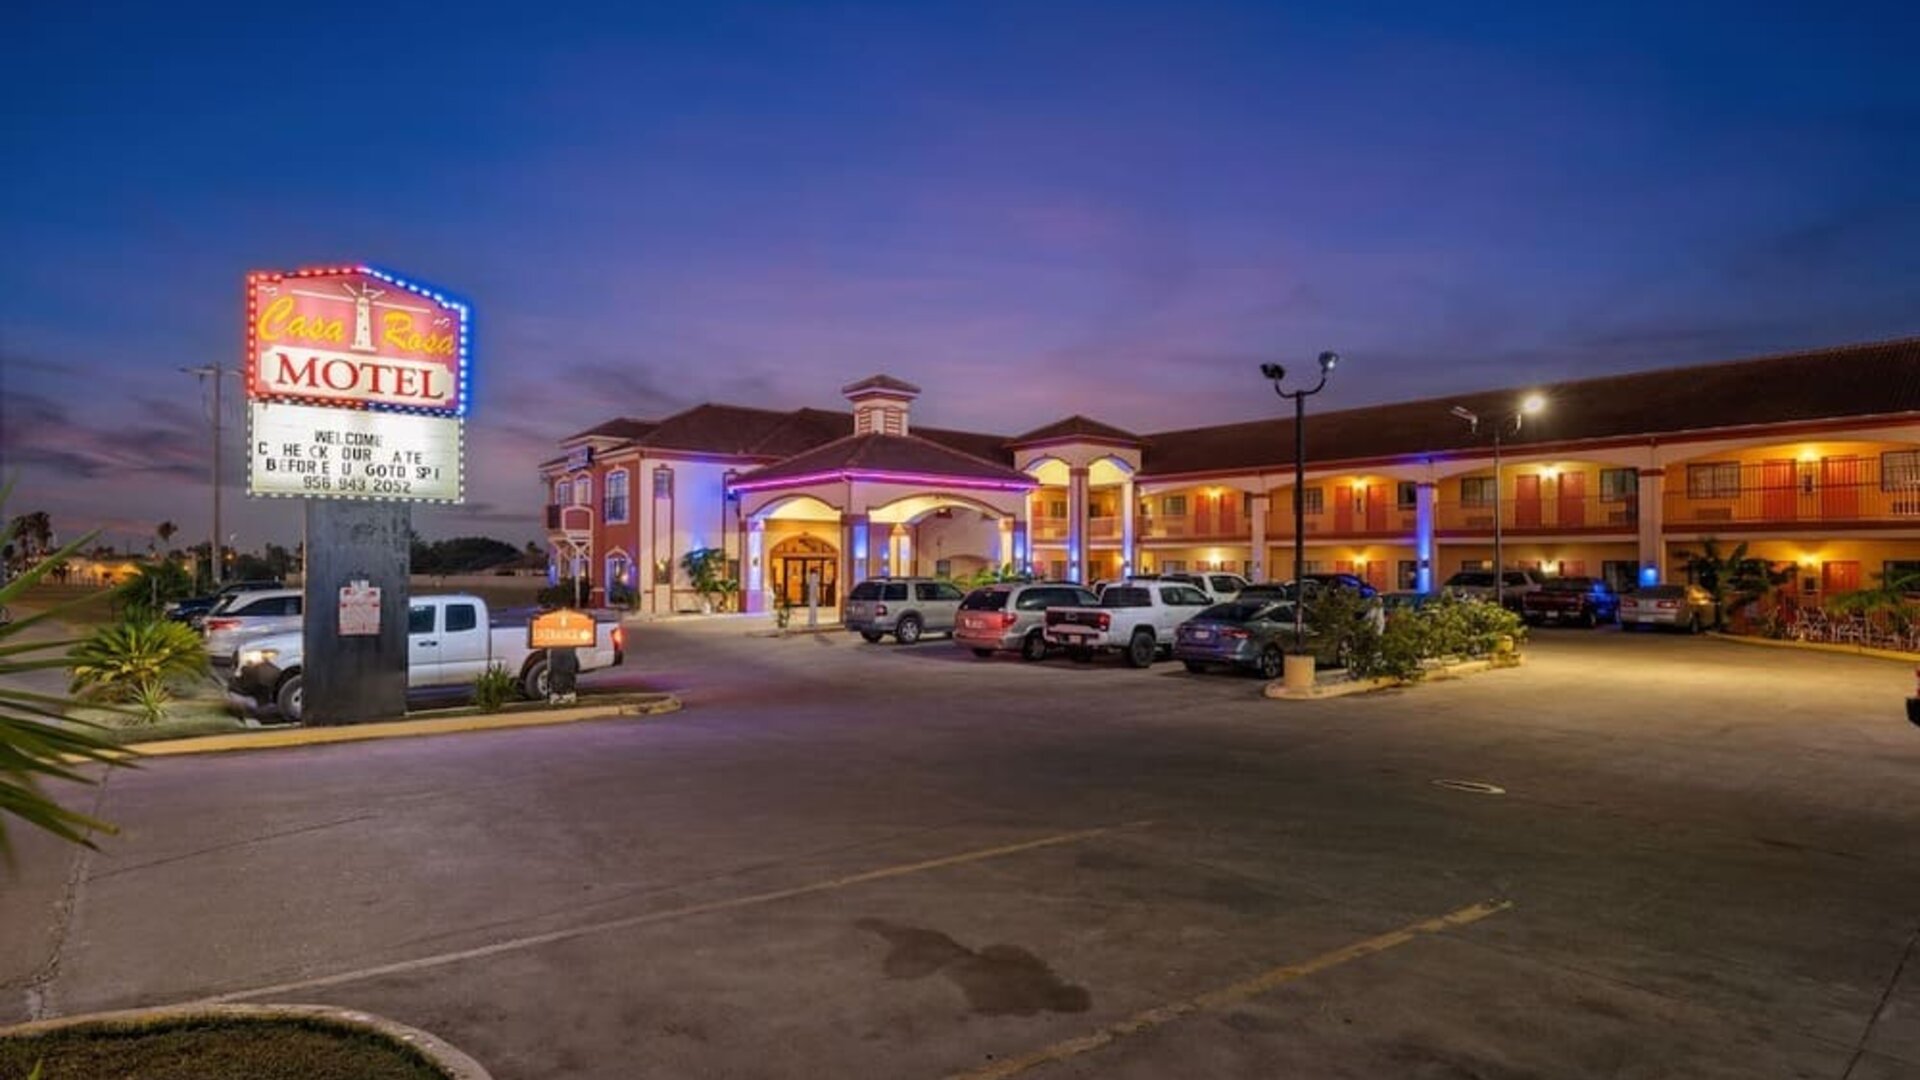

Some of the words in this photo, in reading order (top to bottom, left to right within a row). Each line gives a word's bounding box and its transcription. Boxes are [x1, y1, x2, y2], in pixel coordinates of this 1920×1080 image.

[259, 297, 343, 342] Casa
[384, 311, 454, 355] Rosa
[276, 353, 444, 400] MOTEL
[314, 430, 383, 447] WELCOME
[342, 447, 372, 462] OUR
[341, 463, 352, 476] U
[303, 476, 331, 490] 956
[339, 478, 366, 491] 943
[373, 479, 412, 494] 2052
